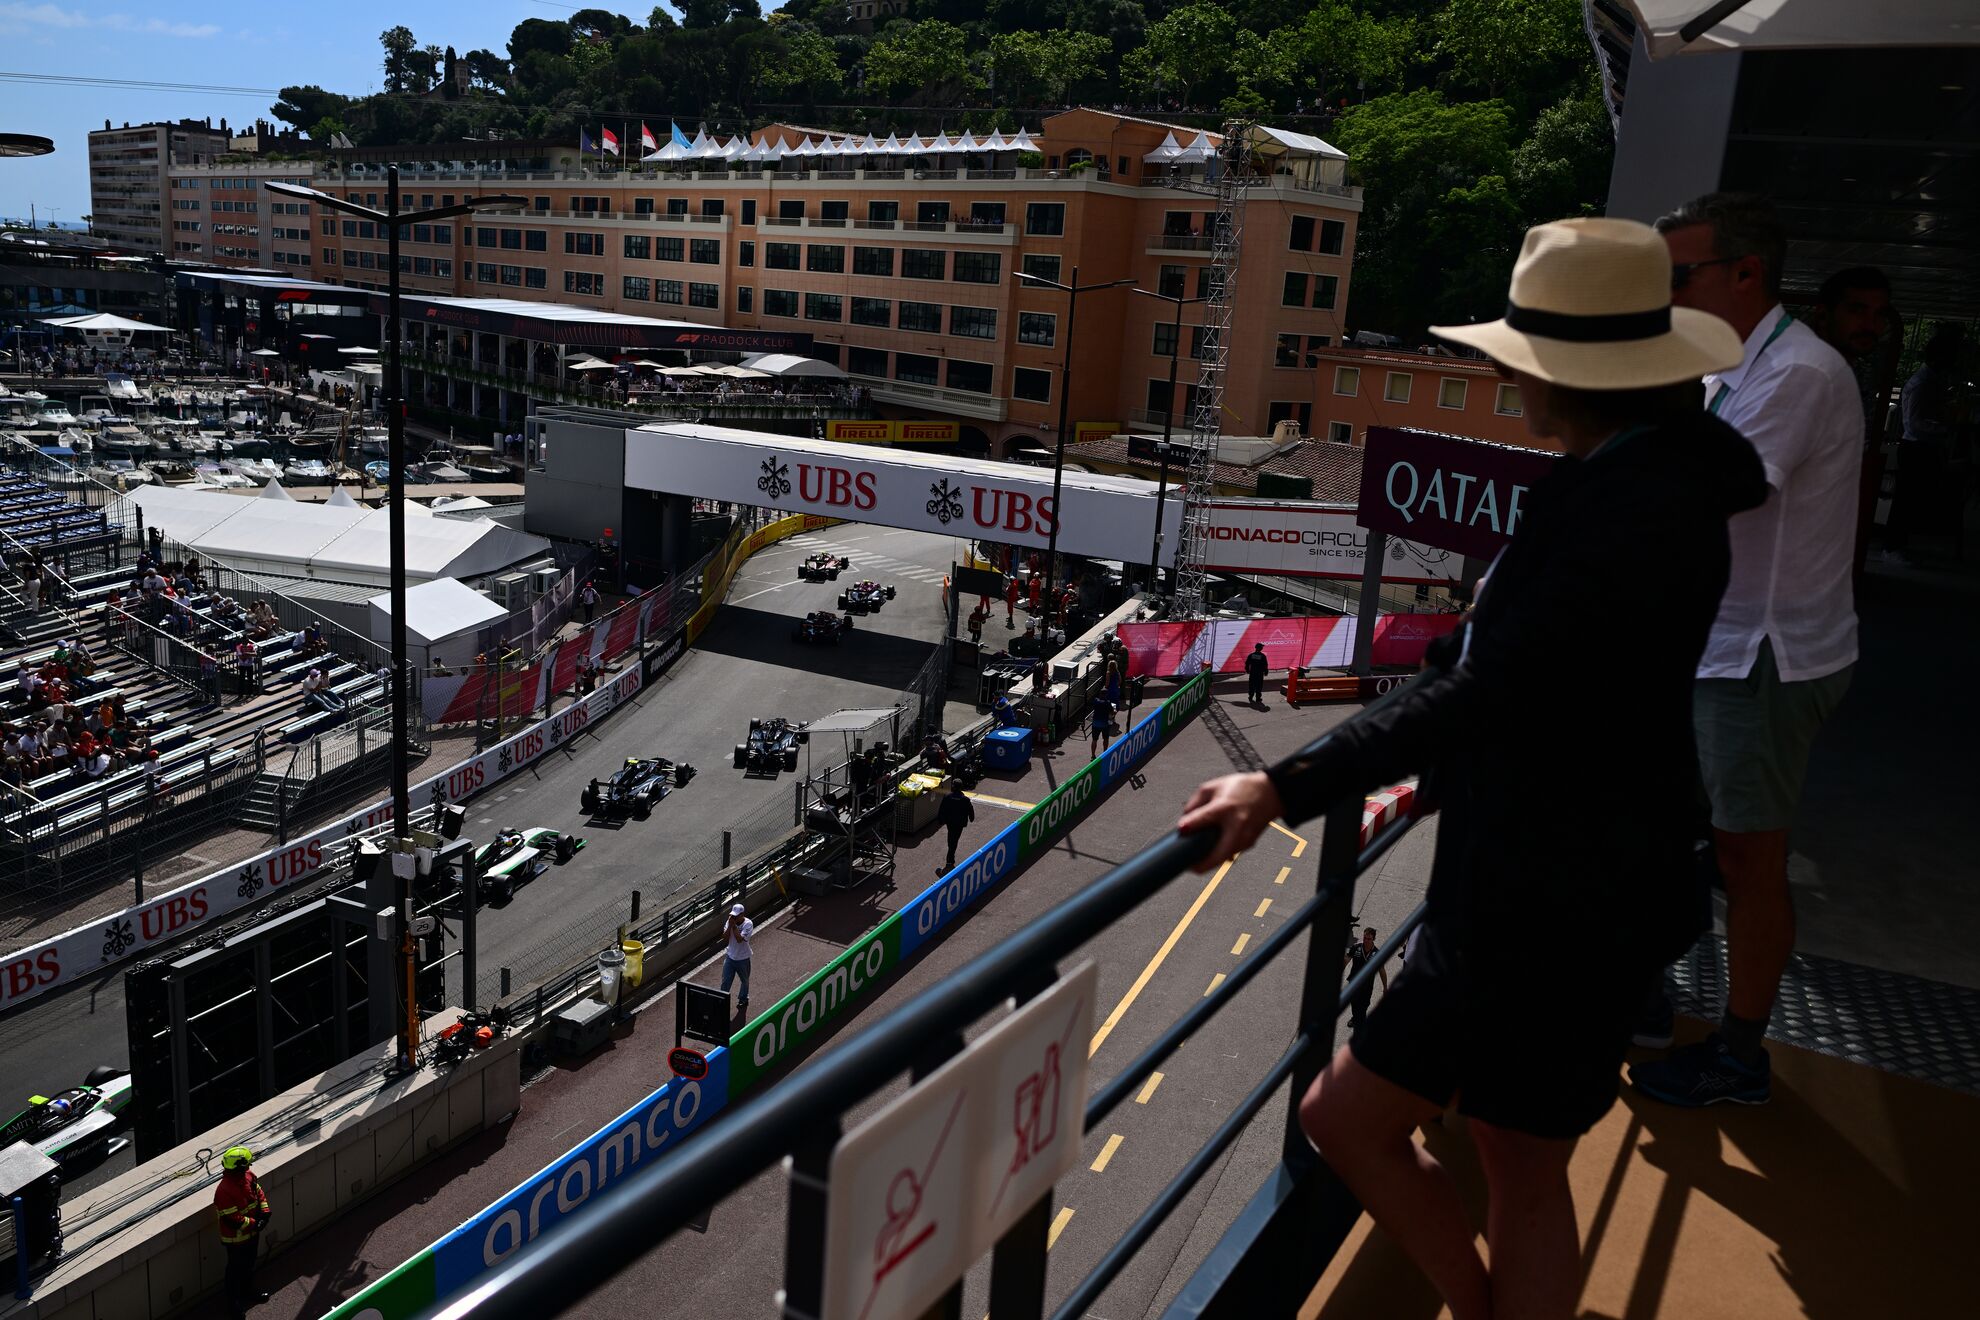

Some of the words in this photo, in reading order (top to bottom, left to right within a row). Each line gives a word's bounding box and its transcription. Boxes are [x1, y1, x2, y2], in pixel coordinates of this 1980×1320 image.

[702, 334, 760, 346] PADDOCK
[763, 337, 794, 348] CLUB
[834, 423, 888, 439] PIRELLI
[903, 424, 954, 439] PIRELLI
[796, 463, 878, 511] UBS
[970, 486, 1061, 538] UBS
[1195, 525, 1369, 548] MONACOCIRCU
[1308, 548, 1342, 558] SINCE
[621, 667, 639, 698] UBS
[1167, 677, 1206, 726] aramco
[563, 702, 589, 736] UBS
[514, 728, 544, 764] UBS
[1108, 718, 1158, 777] aramco
[448, 760, 485, 800] UBS
[1028, 771, 1094, 846] aramco
[266, 838, 324, 887] UBS
[917, 841, 1007, 936] aramco
[138, 887, 210, 941] UBS
[416, 923, 430, 933] 29
[752, 938, 885, 1068] aramco
[482, 1079, 702, 1268] aramco
